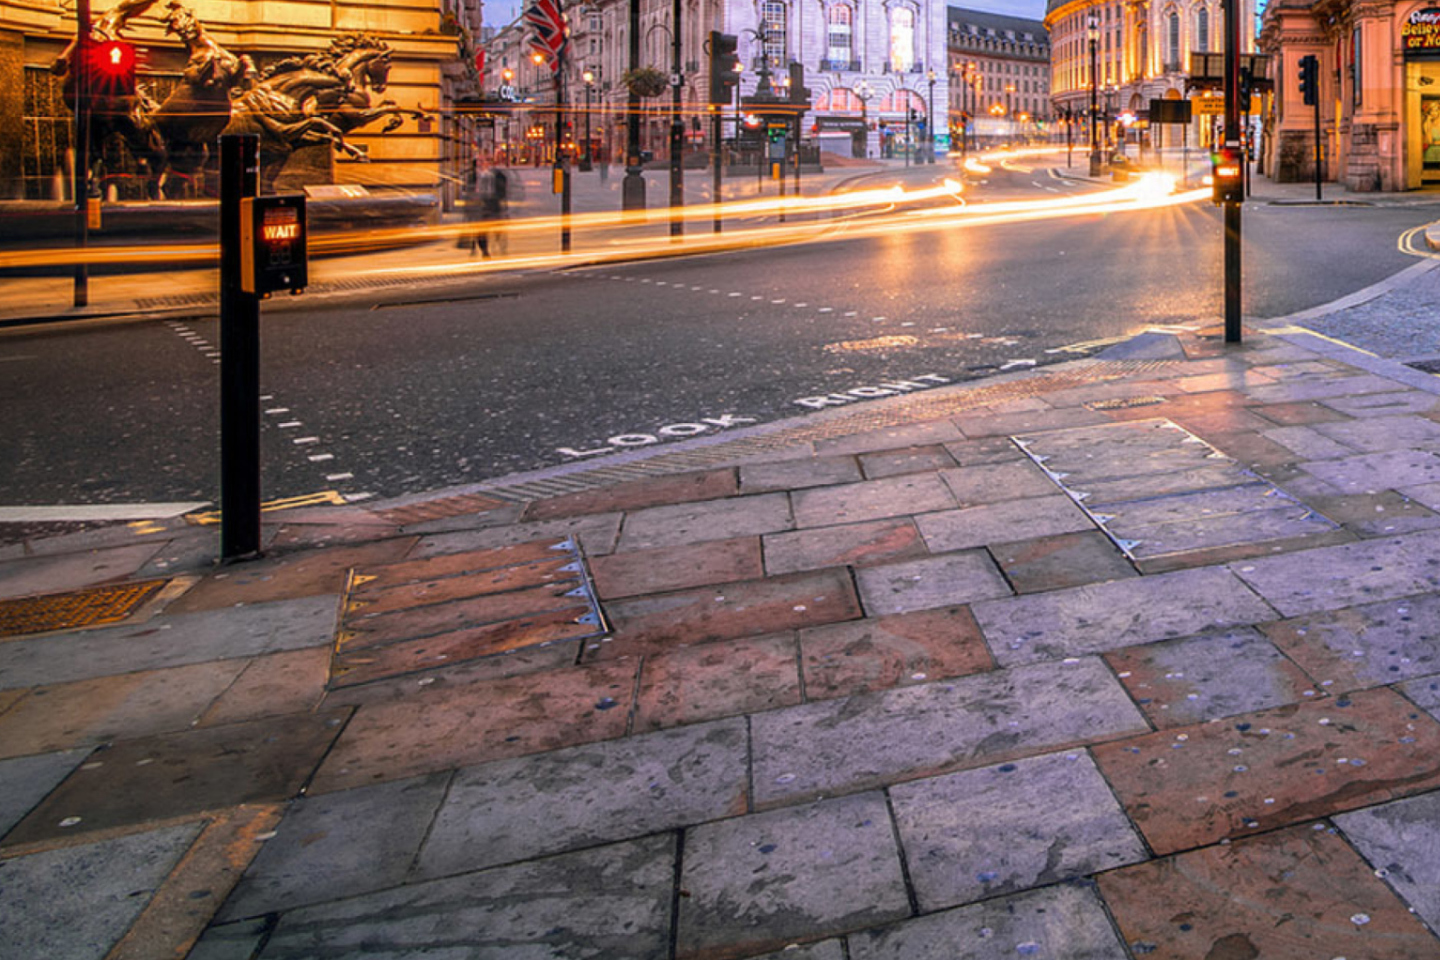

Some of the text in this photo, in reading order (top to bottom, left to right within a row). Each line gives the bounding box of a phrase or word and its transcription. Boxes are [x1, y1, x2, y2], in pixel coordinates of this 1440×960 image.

[1407, 36, 1423, 48] or
[263, 224, 297, 240] WAIT
[556, 372, 951, 457] LOOK RIGHT
